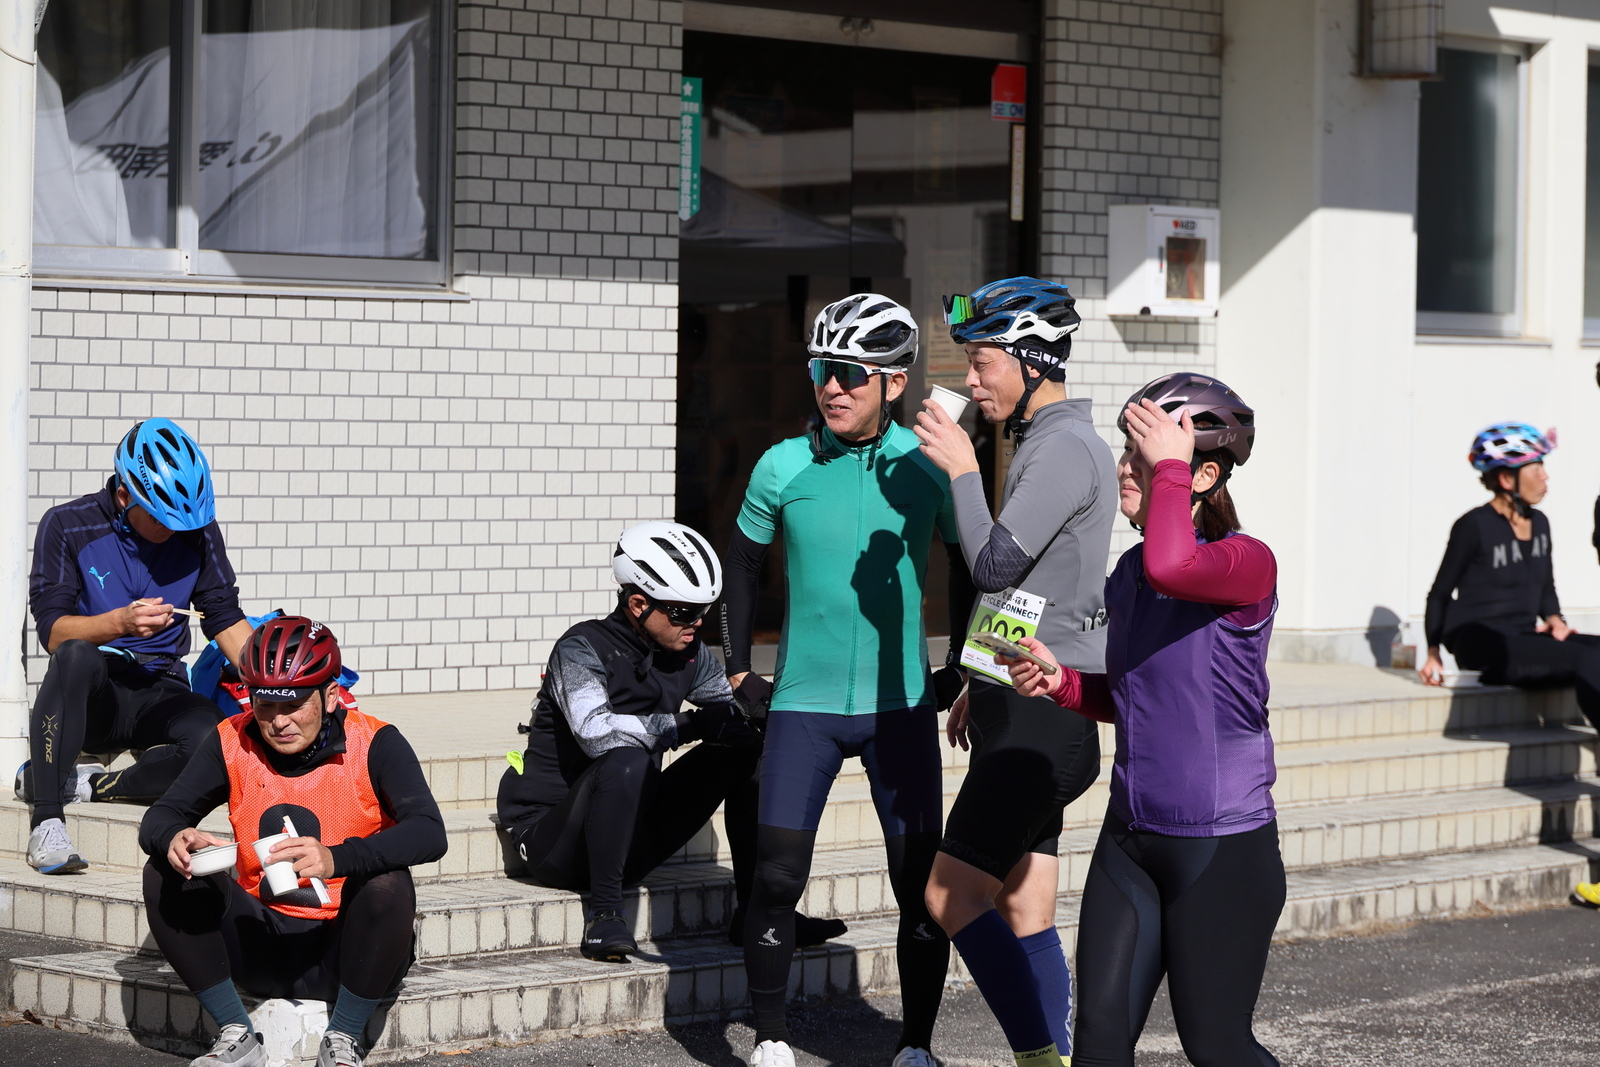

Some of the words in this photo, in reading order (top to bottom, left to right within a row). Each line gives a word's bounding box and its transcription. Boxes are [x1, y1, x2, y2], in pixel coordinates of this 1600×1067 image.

[1180, 220, 1196, 230] AED
[1217, 432, 1237, 447] Liv
[139, 463, 152, 491] GIRO
[982, 594, 1001, 607] CYCLE
[1001, 602, 1039, 621] CONNECT
[721, 603, 732, 657] SHIMANO
[45, 737, 53, 764] 2XU
